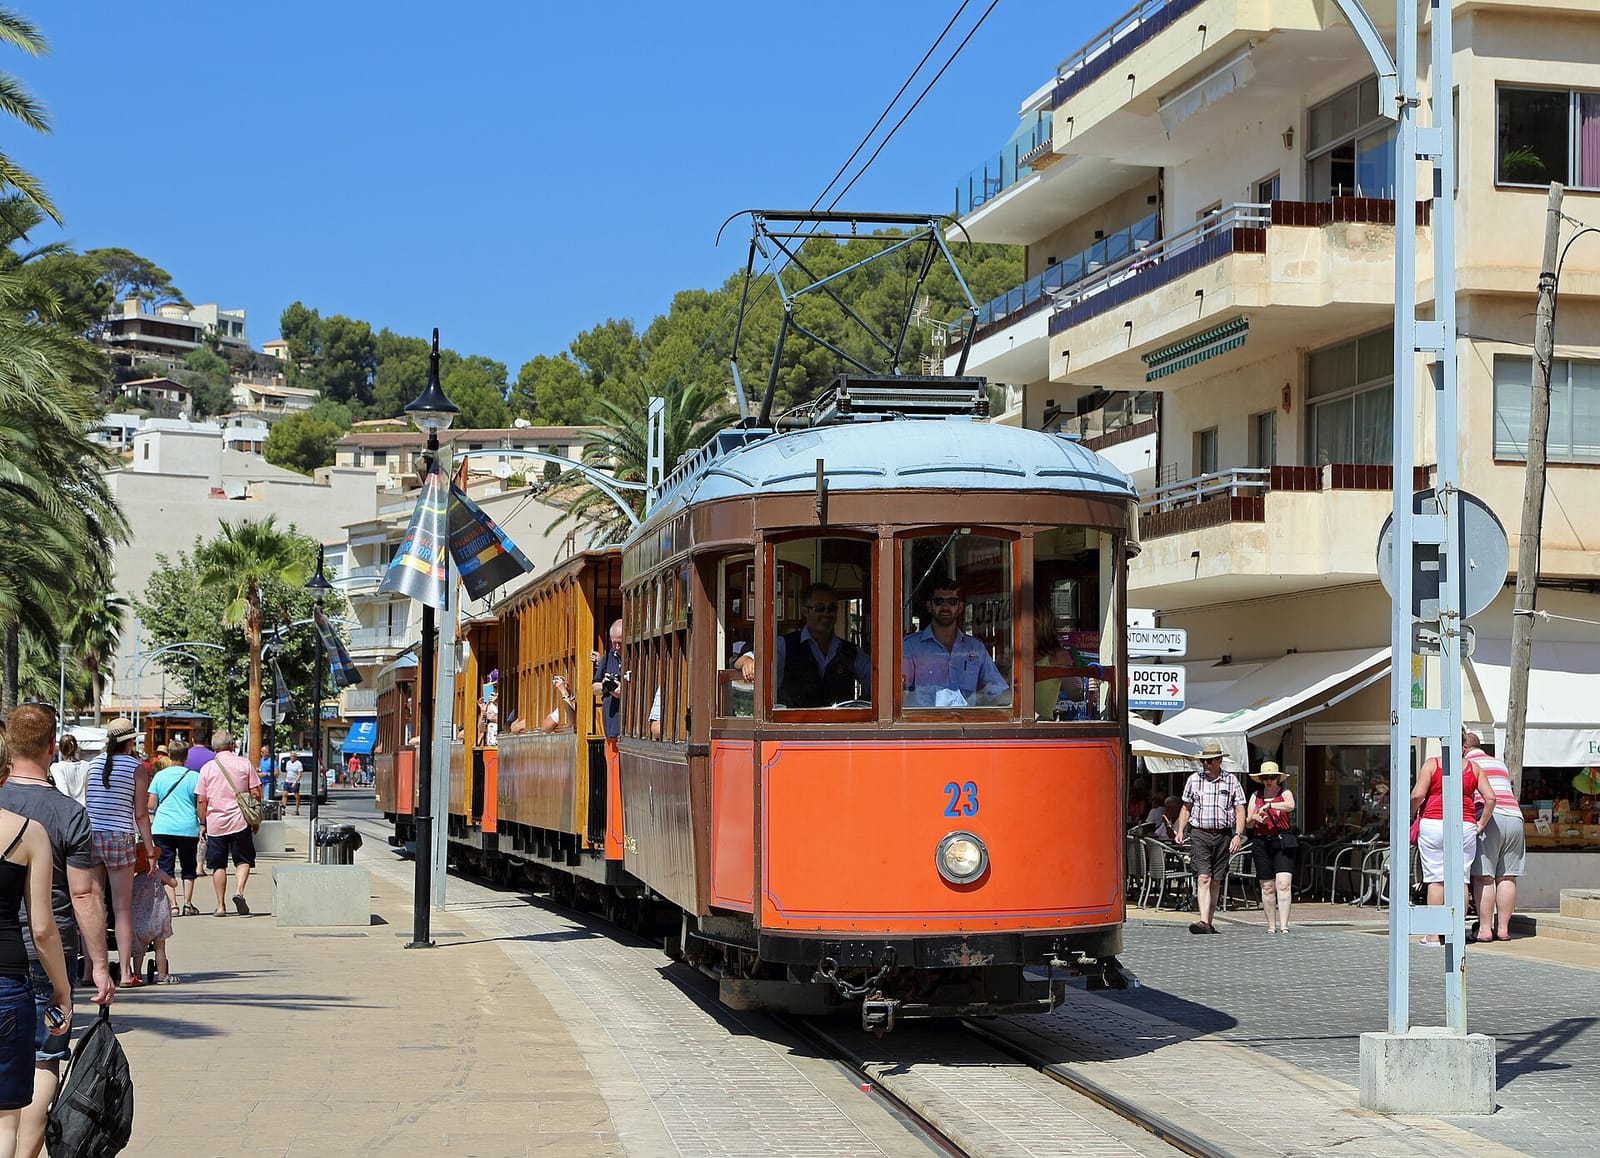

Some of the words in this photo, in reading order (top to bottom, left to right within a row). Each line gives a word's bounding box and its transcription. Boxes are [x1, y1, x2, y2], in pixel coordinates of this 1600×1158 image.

[1152, 634, 1181, 644] MONTIS
[1133, 671, 1178, 682] DOCTOR
[1133, 684, 1163, 695] ARZT
[943, 780, 979, 817] 23
